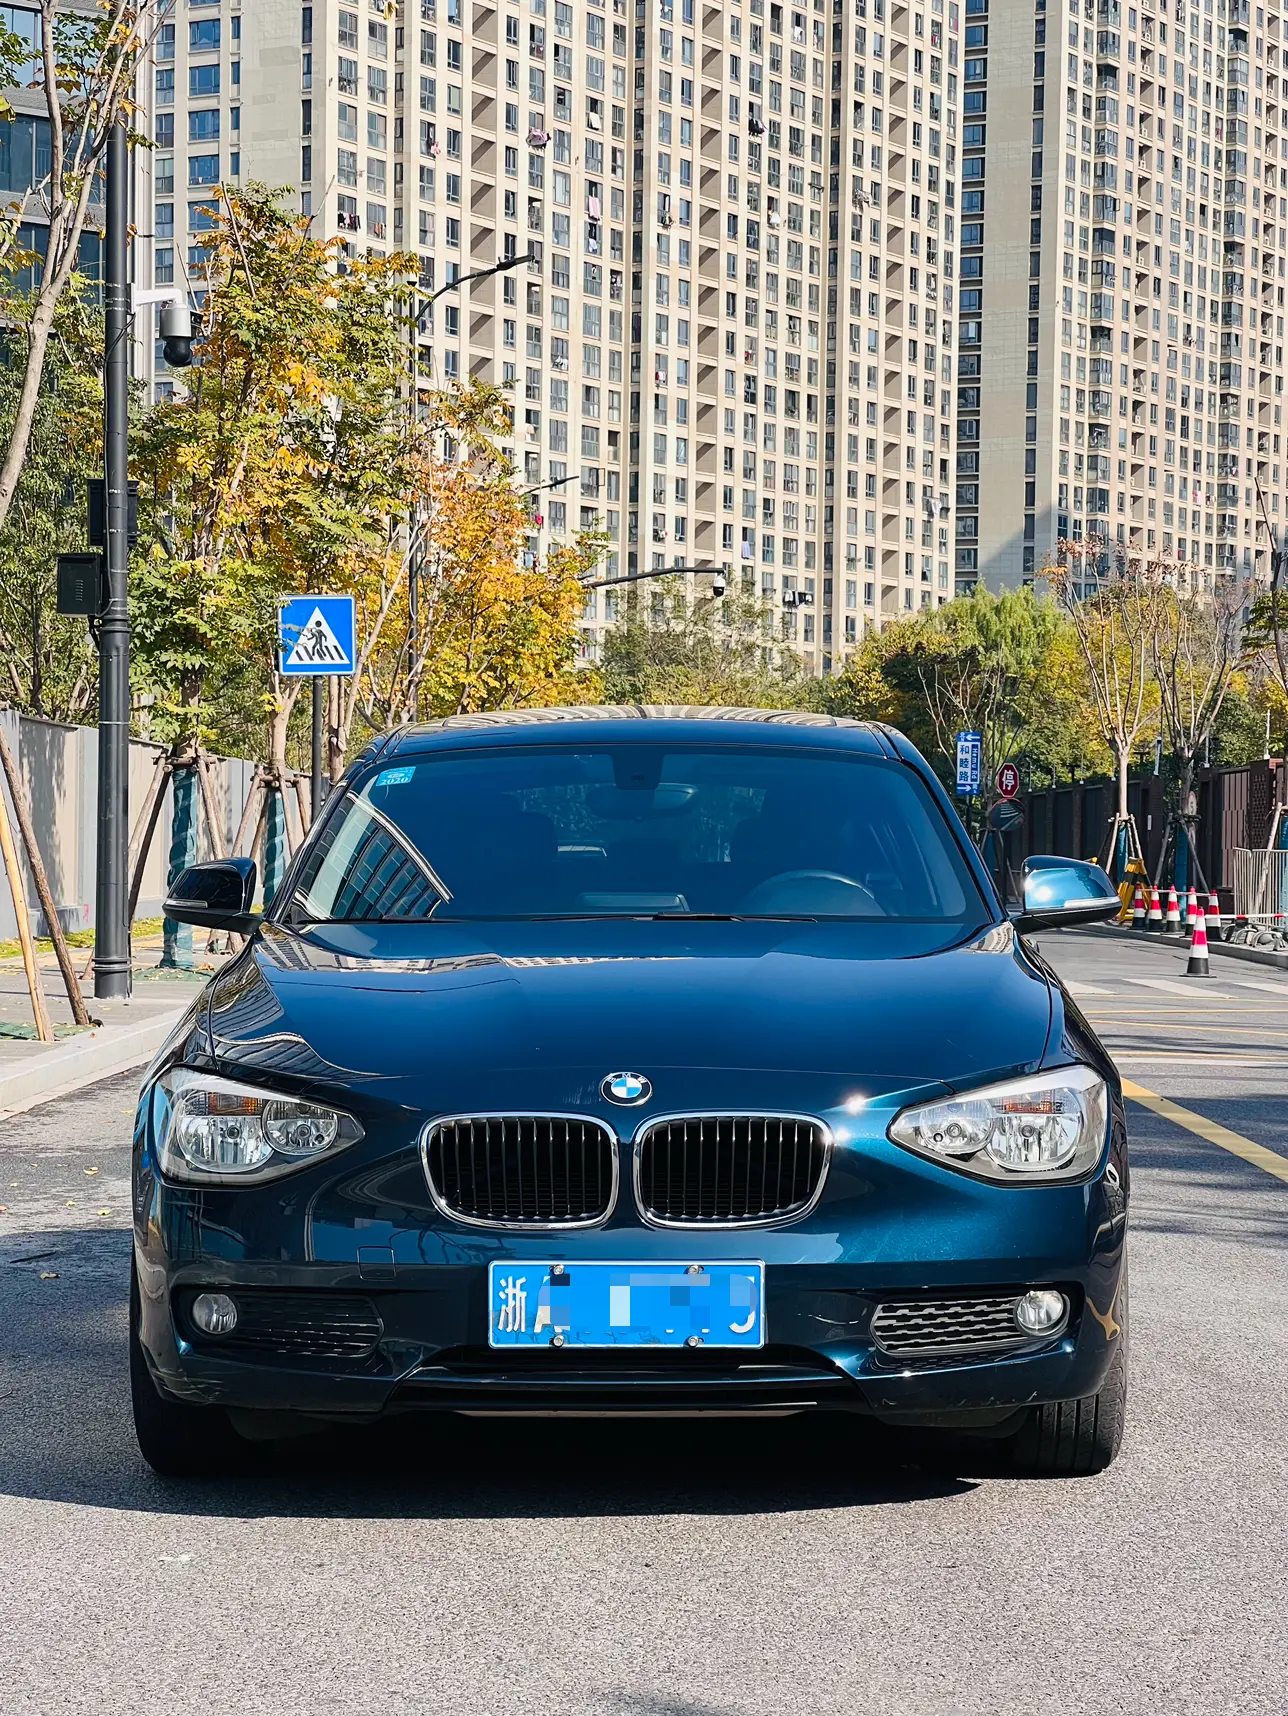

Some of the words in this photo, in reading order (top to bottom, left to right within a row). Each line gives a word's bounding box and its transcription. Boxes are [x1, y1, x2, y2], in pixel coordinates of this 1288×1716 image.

[959, 744, 970, 782] 和睦路
[381, 776, 410, 785] 2020
[971, 770, 978, 780] Rd
[1002, 769, 1015, 790] 停
[607, 1073, 649, 1084] BMW
